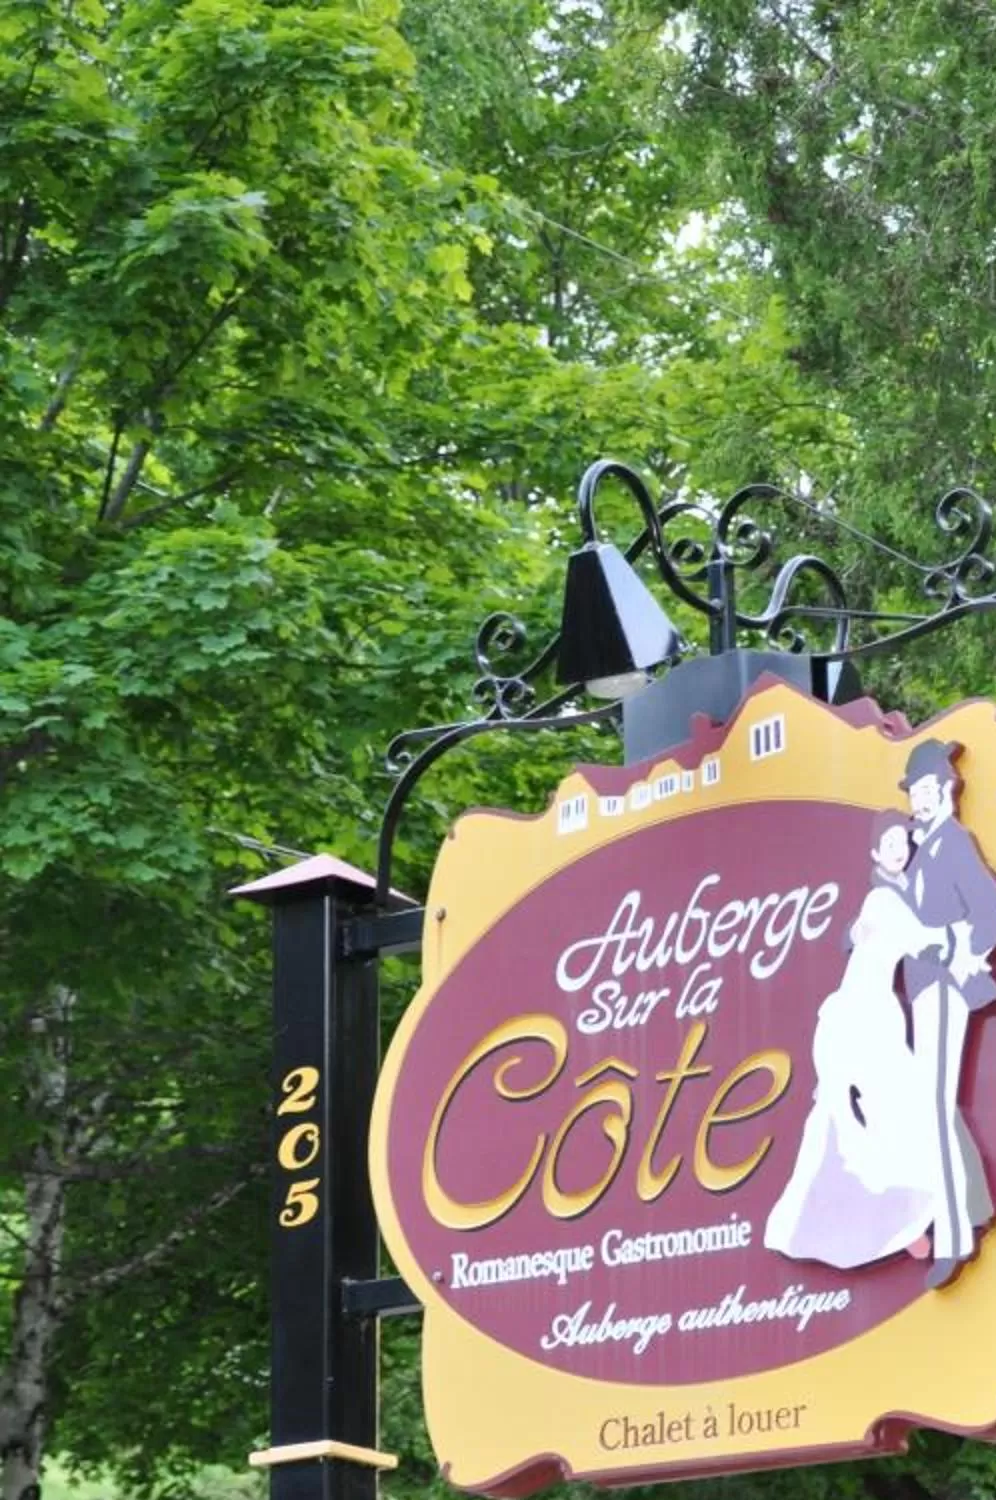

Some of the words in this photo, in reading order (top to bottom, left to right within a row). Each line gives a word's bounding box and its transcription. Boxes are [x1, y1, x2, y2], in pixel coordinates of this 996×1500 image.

[555, 873, 840, 992] Auberge
[576, 979, 671, 1034] Sur
[675, 962, 723, 1019] la
[276, 1066, 321, 1228] 205
[422, 1012, 793, 1232] Côte
[450, 1244, 594, 1289] Romanesque
[601, 1212, 753, 1268] Gastronomie
[540, 1301, 672, 1355] Auberge
[678, 1284, 852, 1331] authentique
[598, 1410, 695, 1451] Chalet
[703, 1405, 719, 1439] à
[727, 1402, 807, 1437] louer
